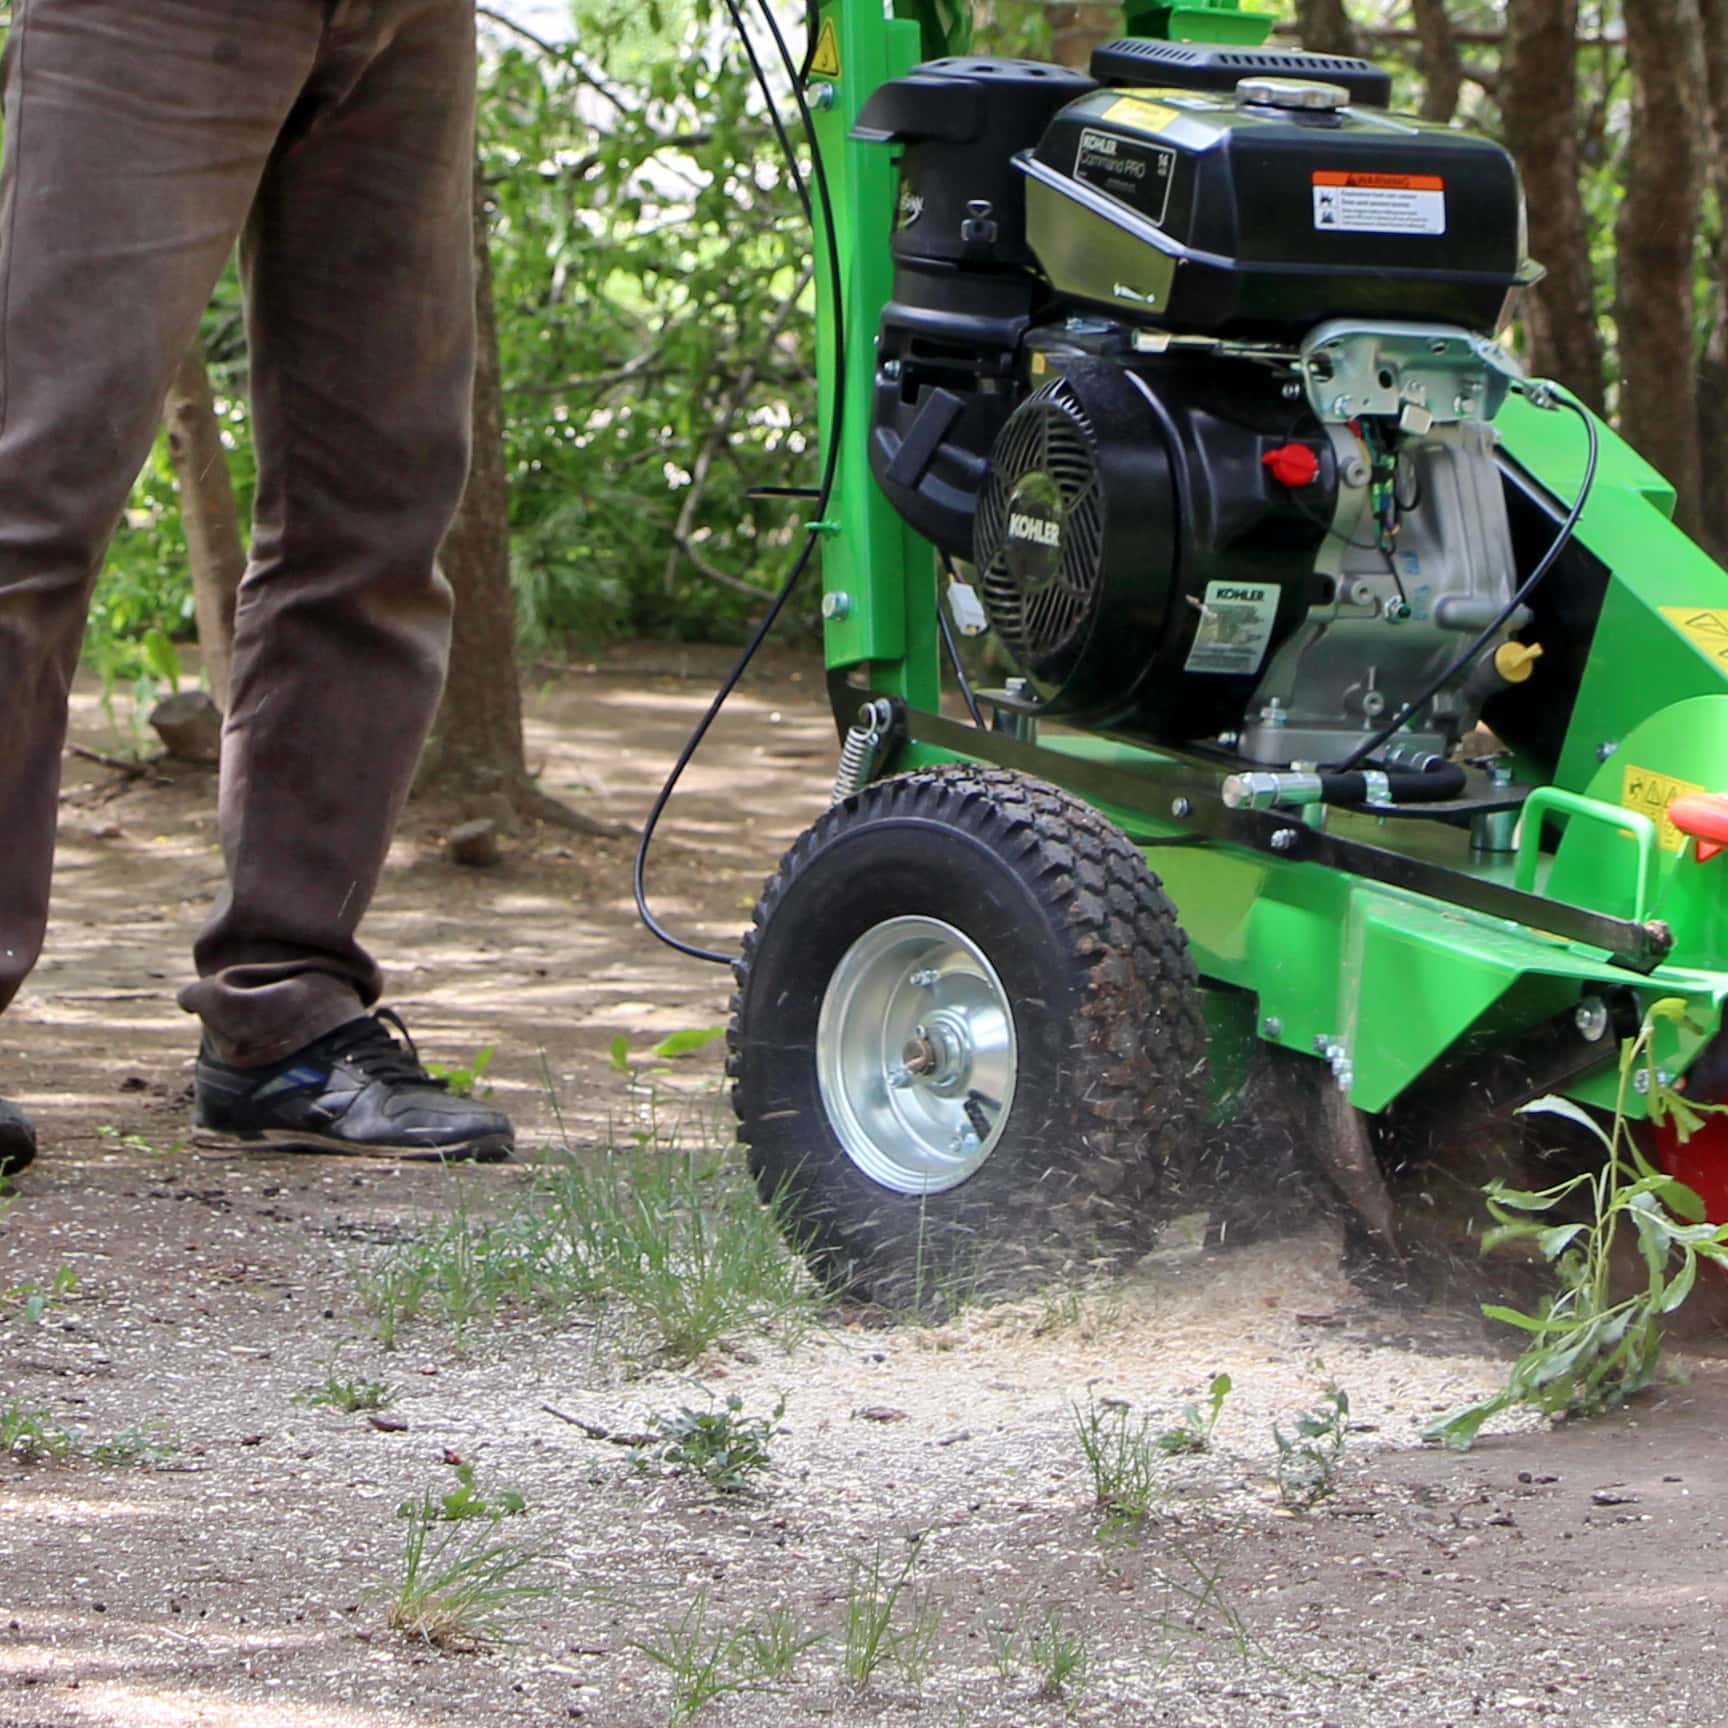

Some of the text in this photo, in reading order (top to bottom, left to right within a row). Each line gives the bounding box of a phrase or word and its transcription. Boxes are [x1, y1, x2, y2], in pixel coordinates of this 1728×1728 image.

[1083, 135, 1118, 155] KOHLER
[1125, 159, 1146, 179] PRO
[1008, 512, 1060, 547] KOHLER
[1216, 587, 1264, 603] KOHLER
